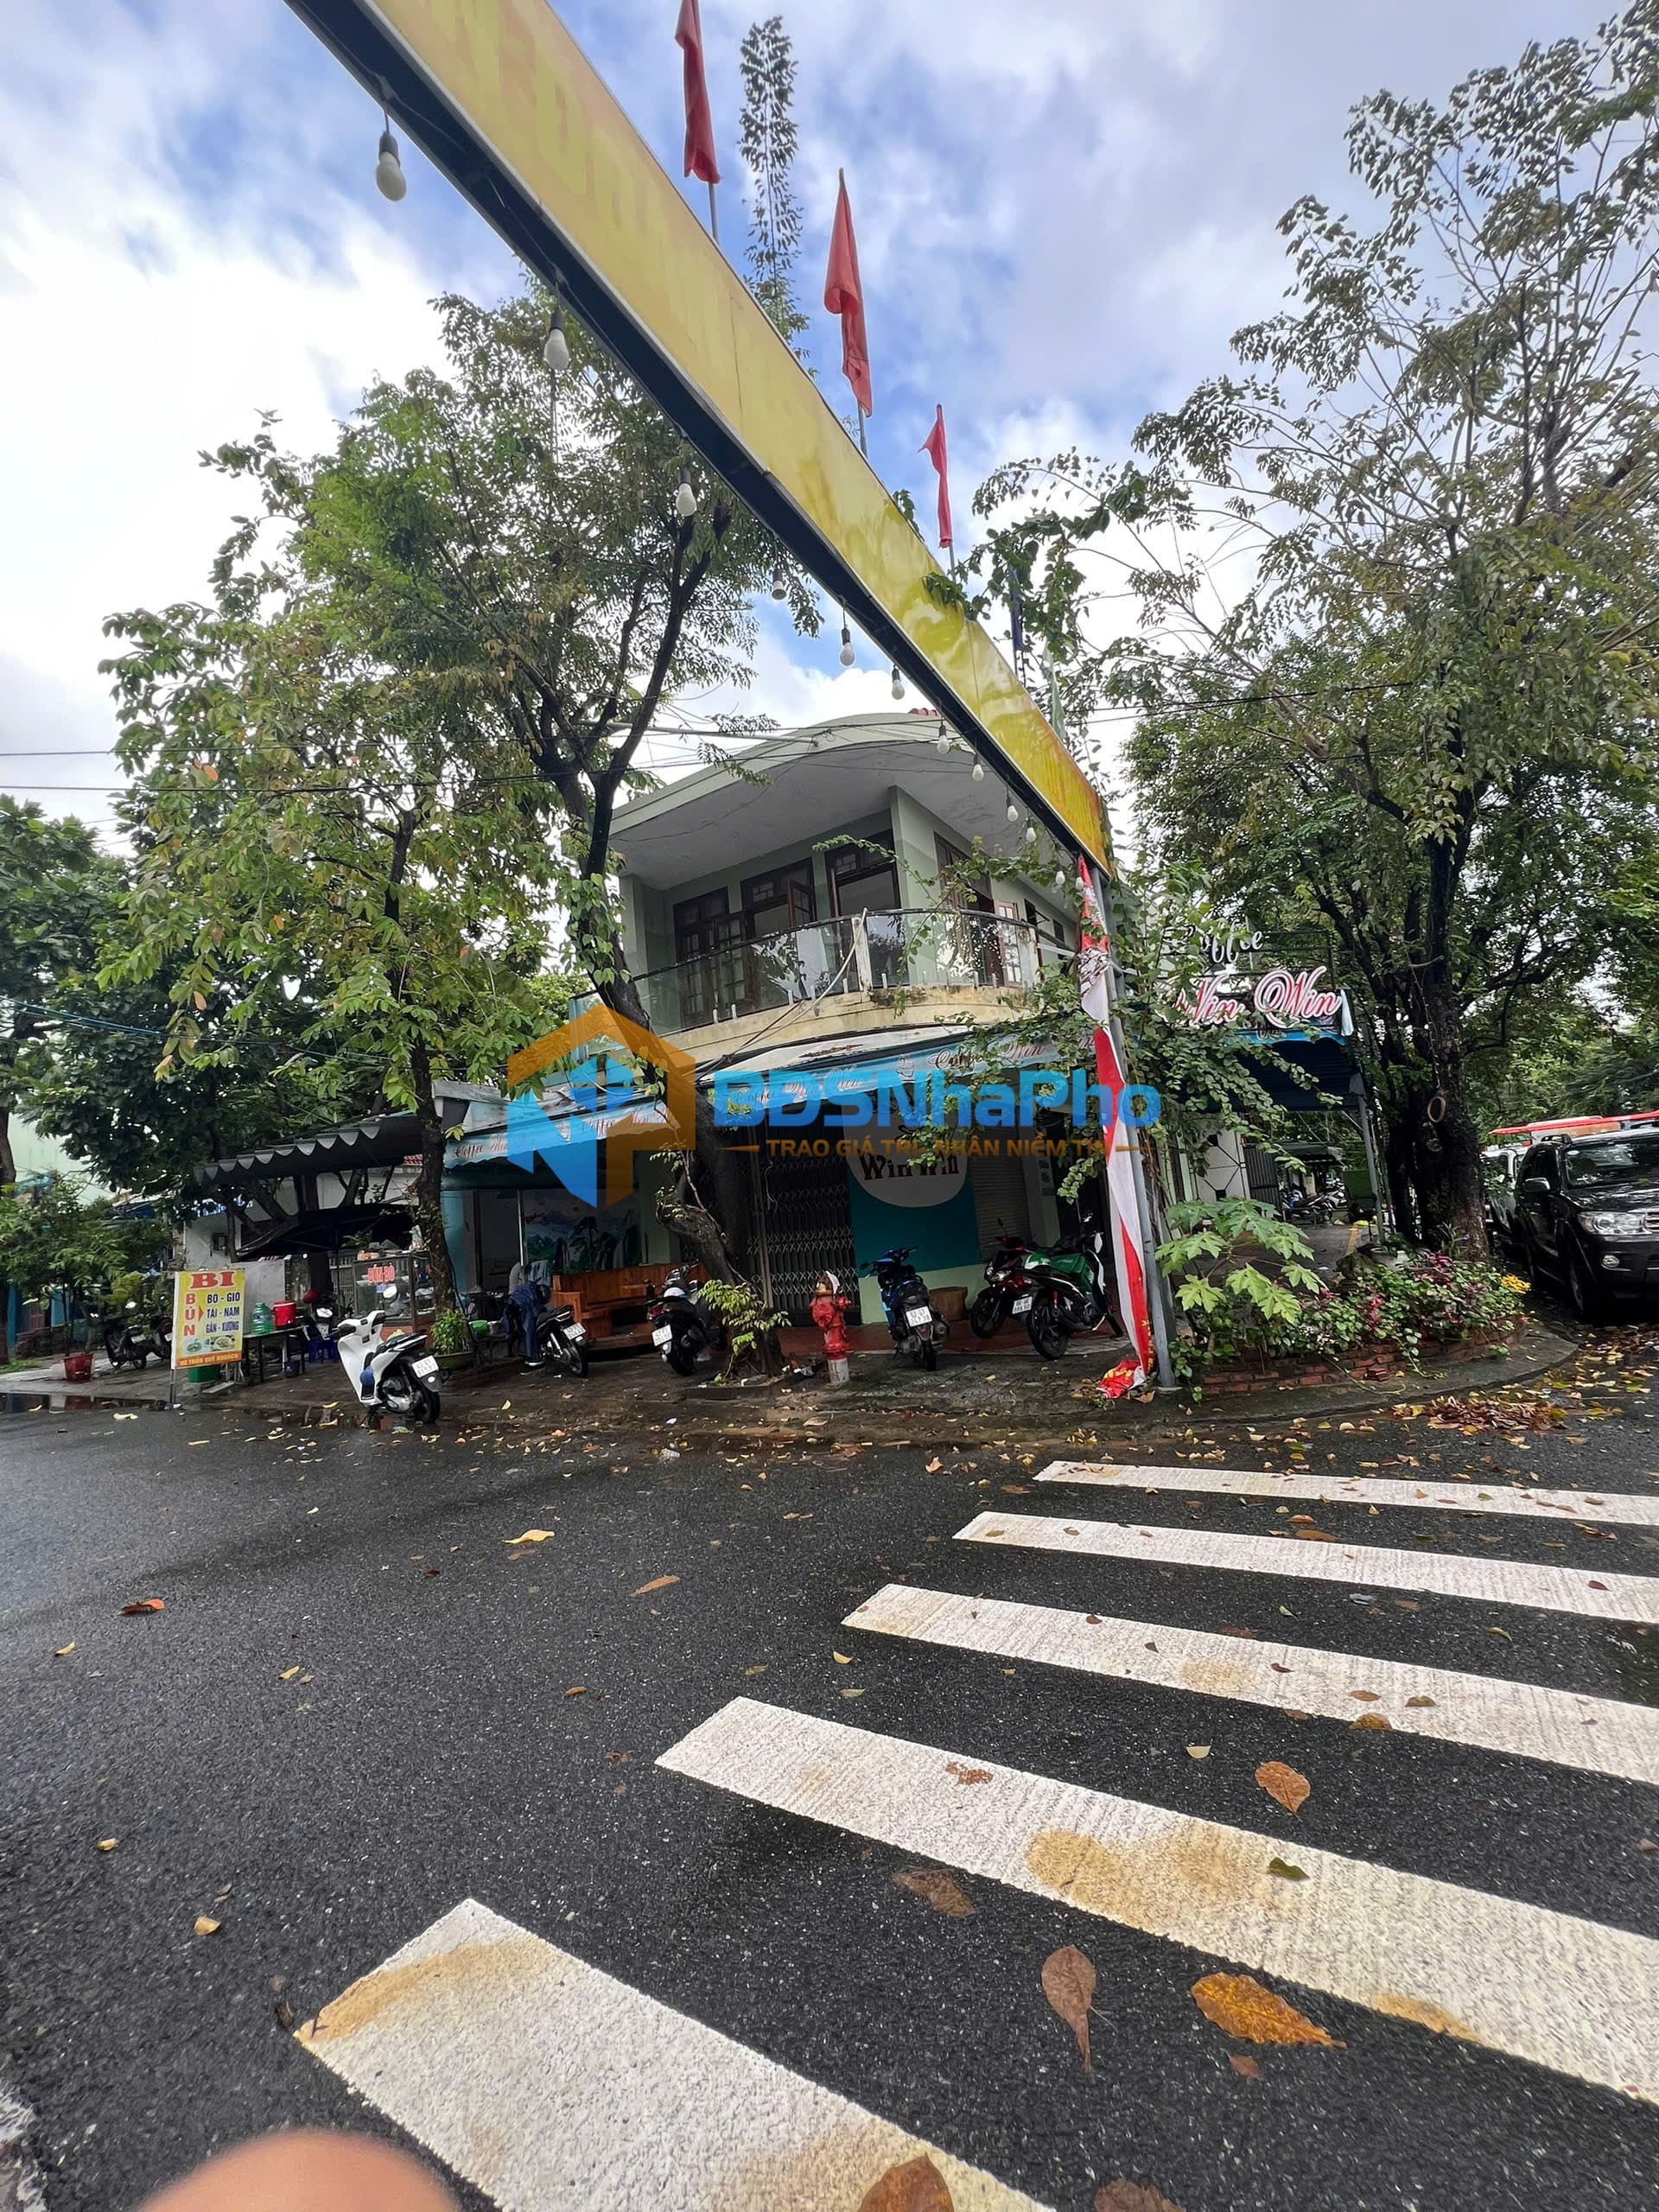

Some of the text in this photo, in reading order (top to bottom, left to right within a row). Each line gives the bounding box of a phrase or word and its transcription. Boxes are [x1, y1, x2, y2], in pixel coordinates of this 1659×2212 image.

[1255, 966, 1342, 1028] Win
[857, 1150, 912, 1180] Win
[190, 1271, 235, 1288] BI
